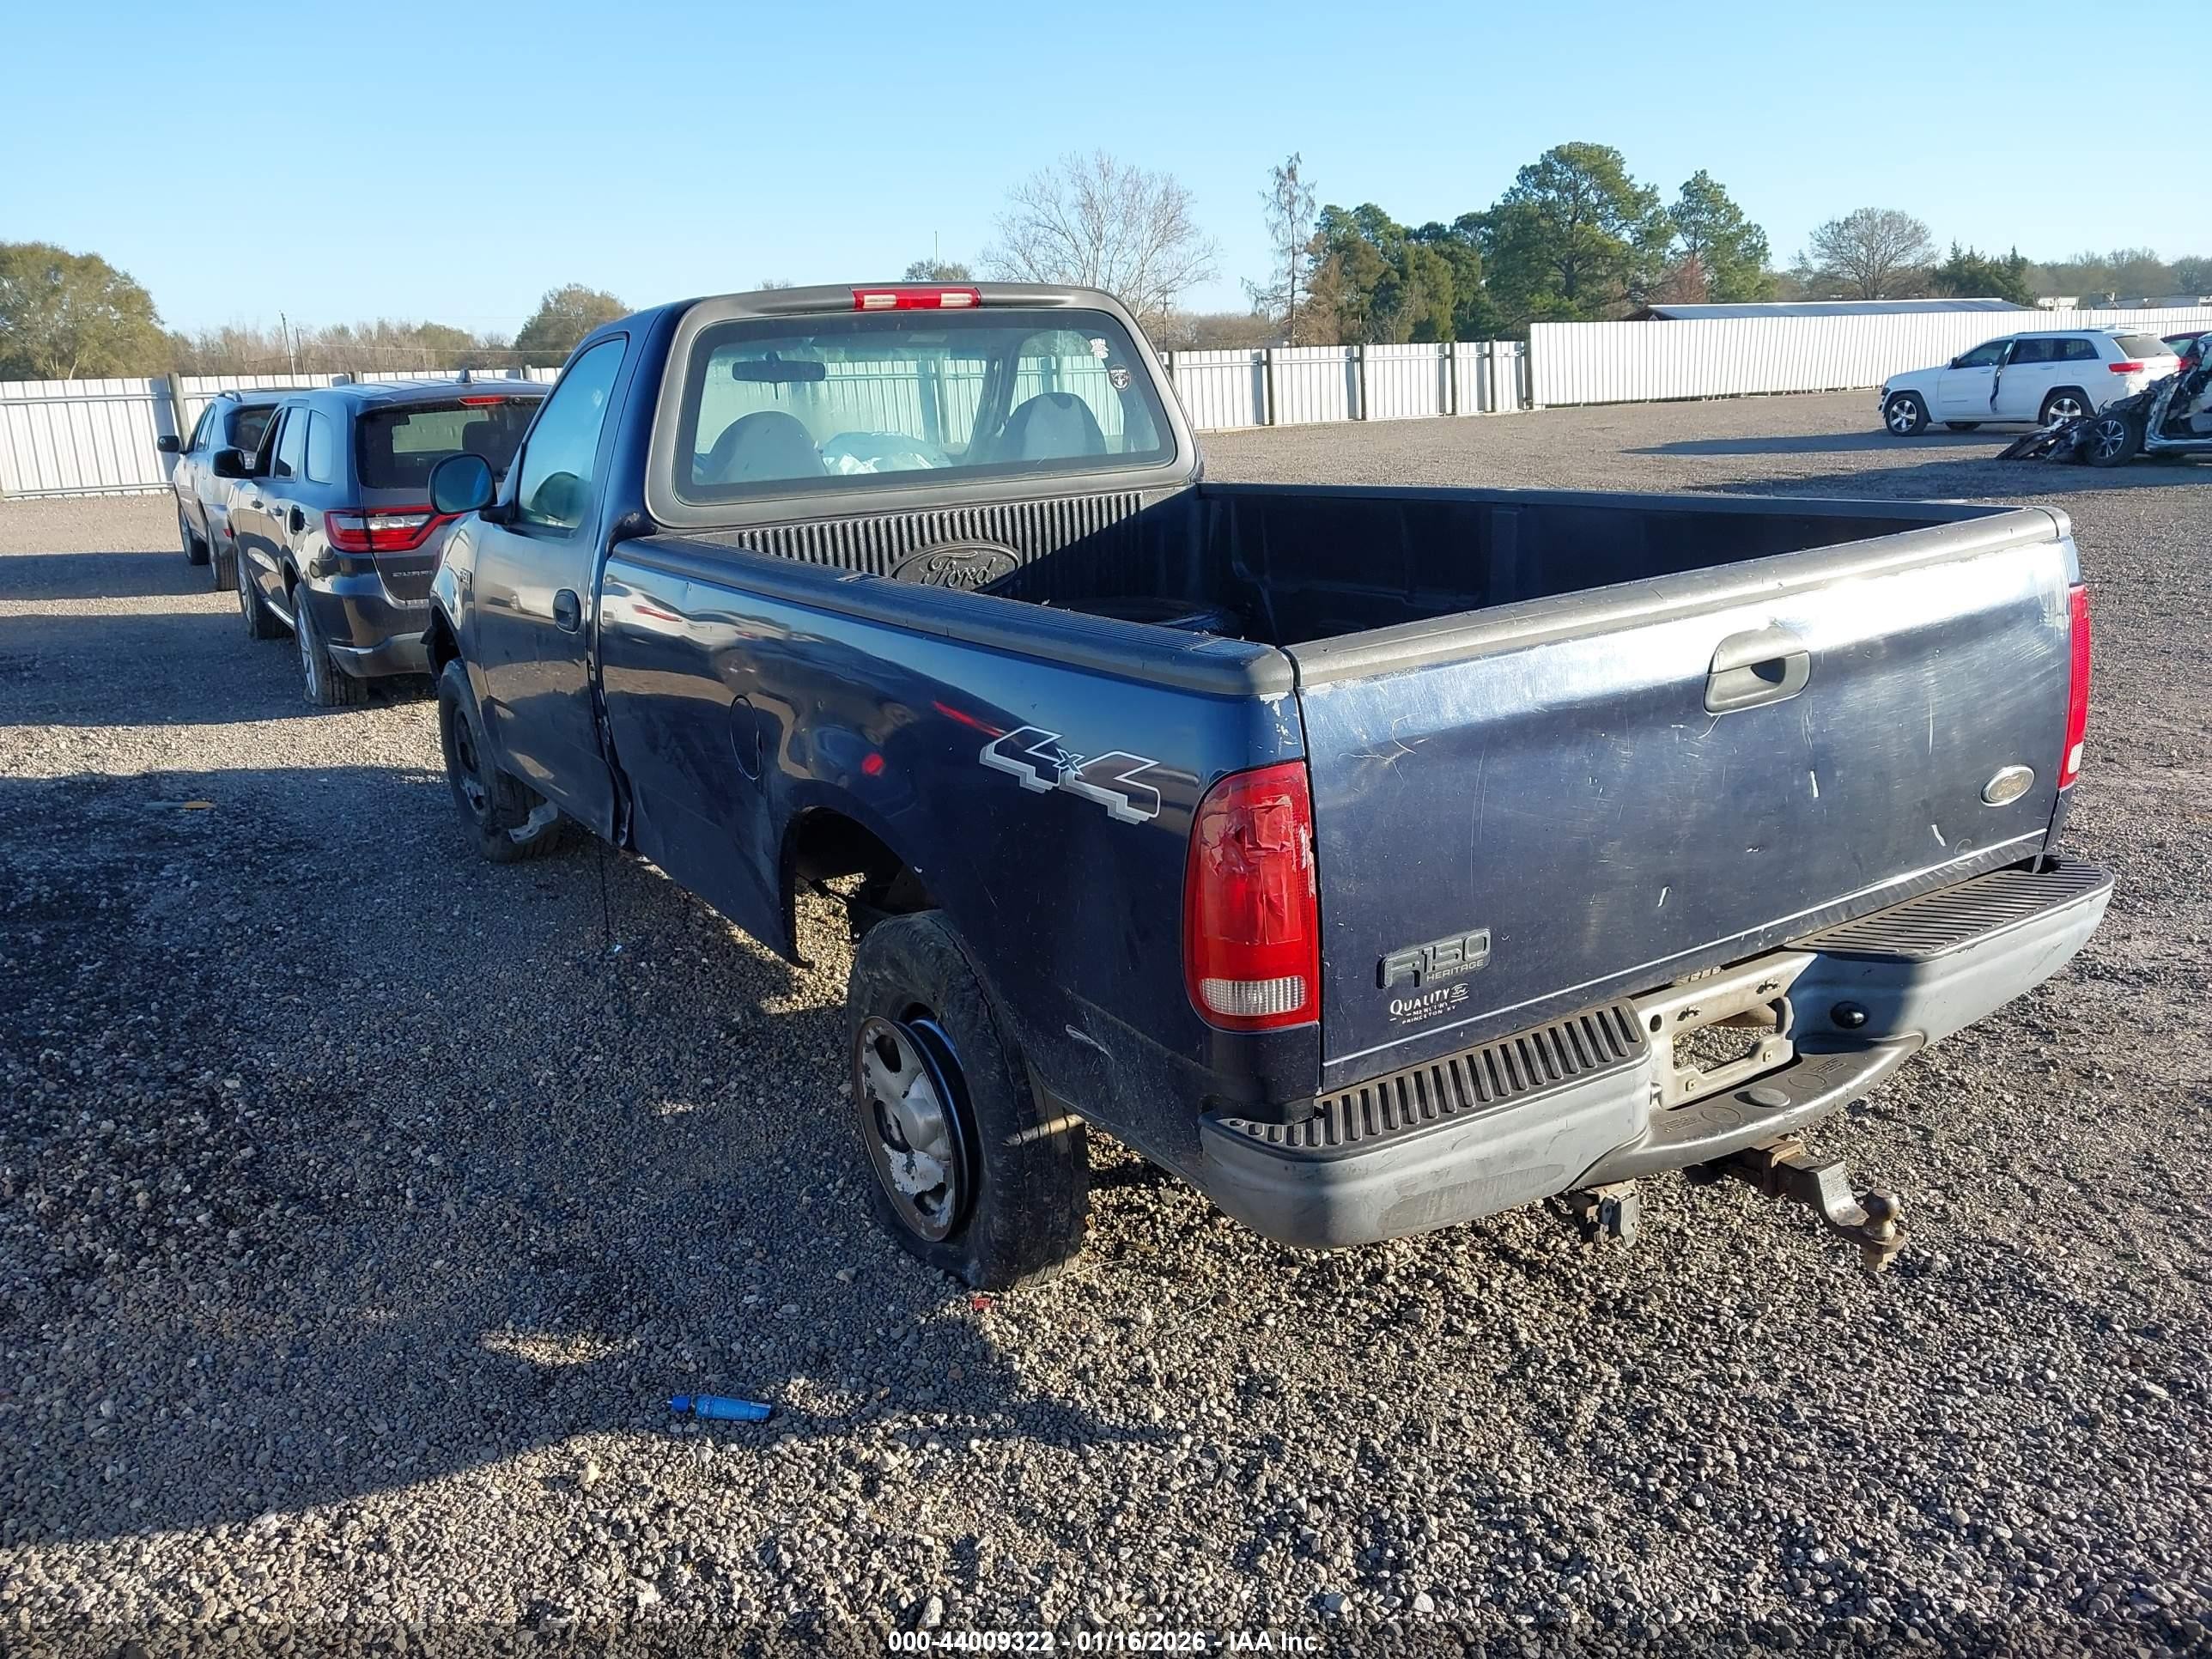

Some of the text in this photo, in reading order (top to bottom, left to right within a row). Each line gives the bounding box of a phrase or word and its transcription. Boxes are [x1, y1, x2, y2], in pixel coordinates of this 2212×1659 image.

[921, 551, 996, 588] Ford
[1426, 958, 1485, 982] HERITAGE
[1390, 988, 1450, 1016] QUALITY
